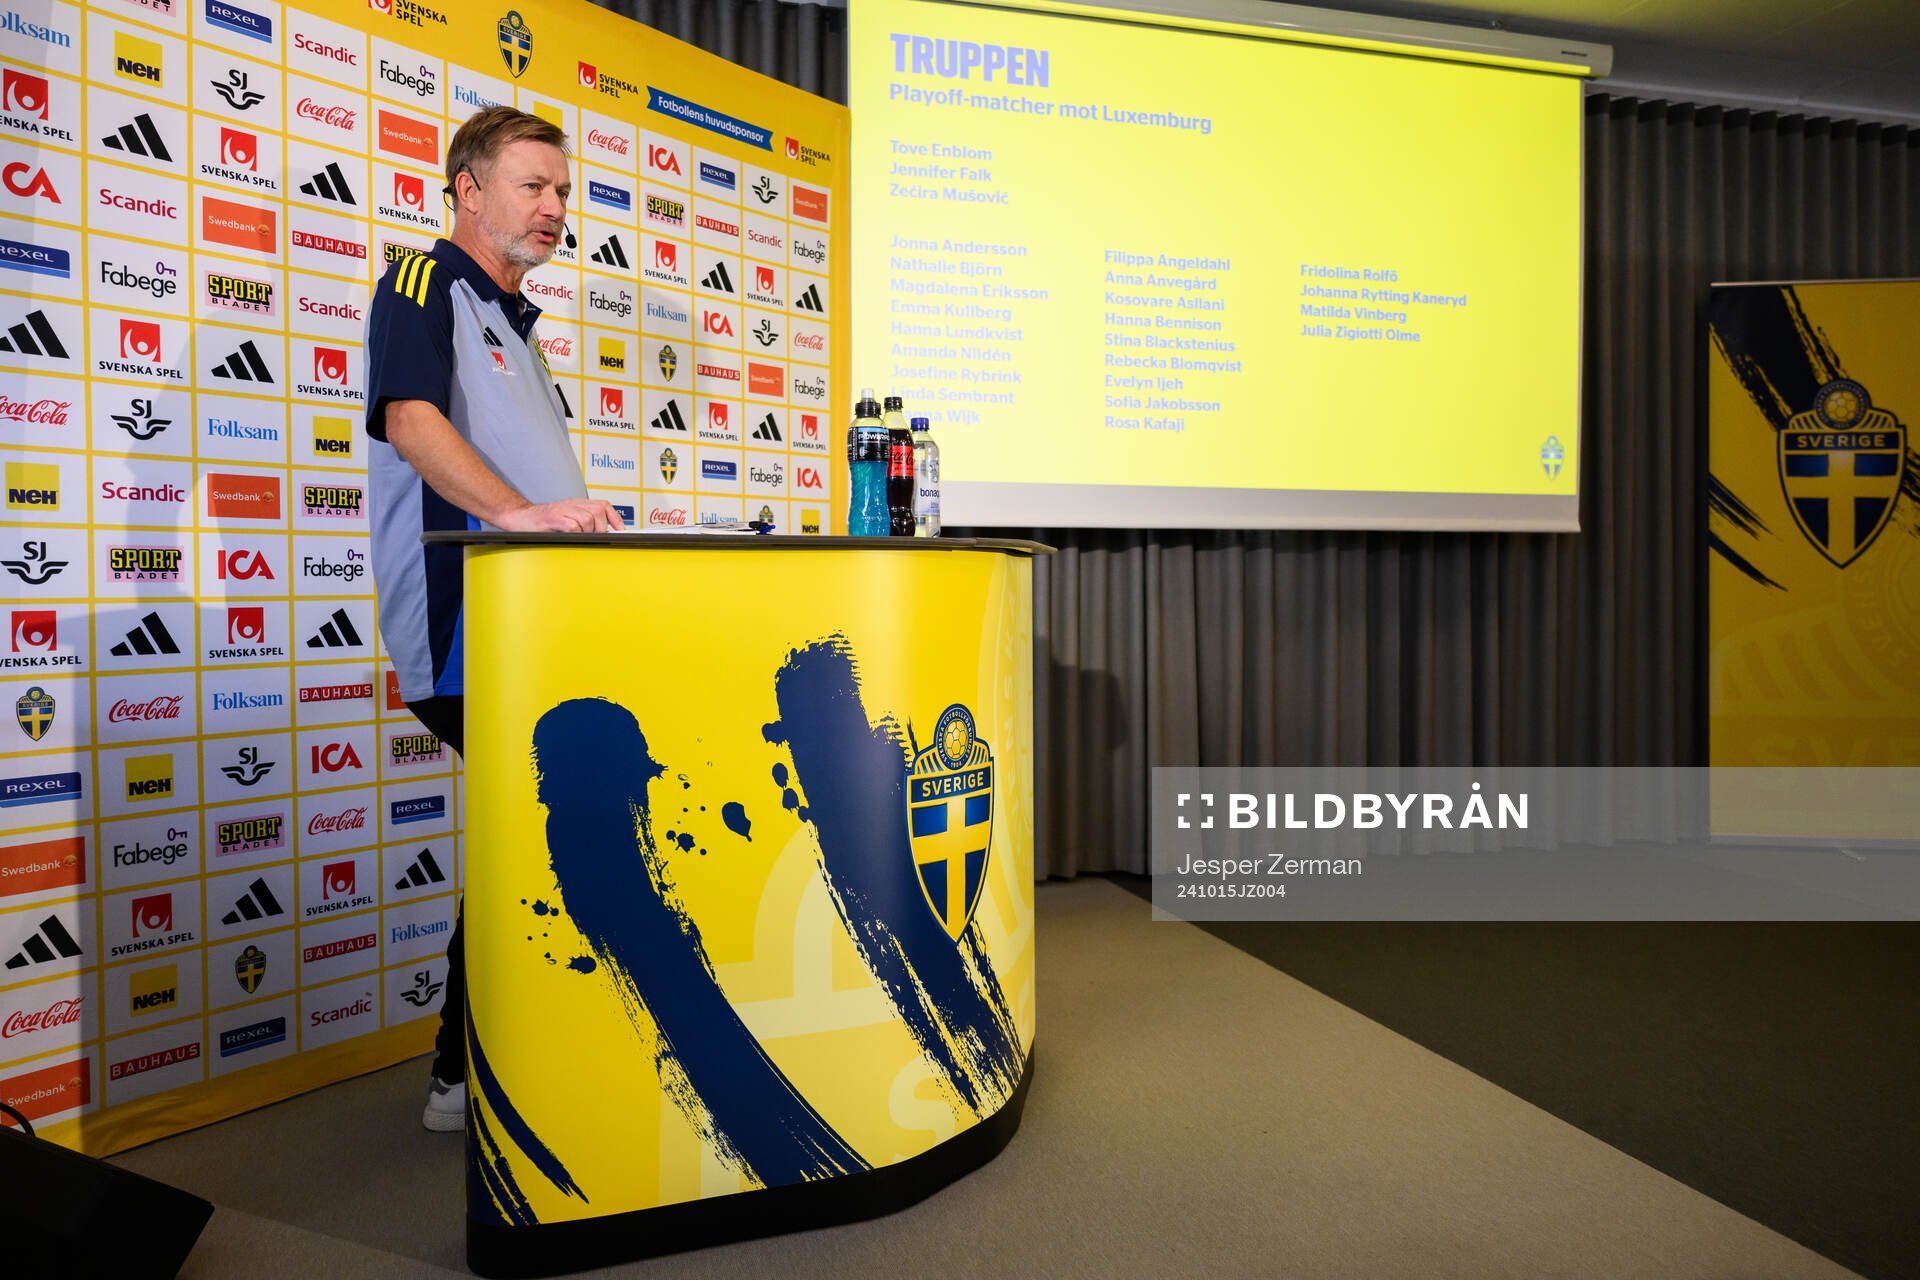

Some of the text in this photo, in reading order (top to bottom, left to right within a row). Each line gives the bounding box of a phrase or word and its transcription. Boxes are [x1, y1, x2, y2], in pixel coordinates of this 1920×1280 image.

[396, 9, 423, 27] SPEL
[0, 11, 71, 48] olksam
[294, 33, 357, 67] Scandic
[890, 33, 1049, 87] TRUPPEN
[229, 69, 248, 90] SJ
[380, 60, 435, 96] Fabege
[600, 74, 639, 95] SVENSKA
[600, 84, 621, 99] SPEL
[296, 97, 356, 132] Coca-Cola
[889, 82, 1212, 134] Playoff-matcher mot Luxemburg
[657, 96, 764, 144] Fotbollens huvudsponsor
[43, 126, 73, 142] SPEL
[383, 127, 422, 145] Swedbank
[588, 129, 630, 155] Coca-Cola
[649, 145, 681, 175] ICA
[890, 140, 993, 161] Tove Enblom
[201, 164, 277, 190] SVENSKA SPEL
[889, 161, 992, 182] Jennifer Falk
[2, 162, 62, 204] CA
[889, 182, 1009, 205] Zećira Mušović
[100, 188, 177, 220] Scandic
[208, 216, 256, 232] Swedbank
[379, 206, 440, 228] SVENSKA SPEL
[697, 216, 739, 237] BAUHAUS
[293, 230, 366, 259] BAUHAUS
[748, 230, 782, 248] Scandic
[890, 234, 1028, 257] Jonna Andersson
[794, 241, 826, 264] Fabege
[1105, 250, 1231, 272] Filippa Angeldahl
[645, 269, 688, 285] SVENSKA SPEL
[890, 256, 1003, 279] Nathalie Björn
[1300, 264, 1398, 282] Fridolina Rolfö
[102, 262, 176, 297] Fabege
[208, 275, 272, 305] SPORT
[526, 279, 573, 300] Scandic
[890, 278, 1049, 301] Magdalena Eriksson
[1105, 271, 1217, 291] Anna Anvegård
[212, 297, 270, 312] BLADET
[590, 291, 632, 318] Fabege
[1105, 292, 1173, 309] Kosovare
[1300, 284, 1467, 308] Johanna Rytting Kaneryd
[299, 297, 361, 321] Scandic
[647, 303, 687, 323] Folksam
[891, 300, 1012, 322] Emma Kullberg
[1300, 304, 1407, 324] Matilda Vinberg
[704, 311, 734, 336] ICA
[891, 321, 1023, 342] Hanna Lundkvist
[1105, 312, 1222, 332] Hanna Bennison
[1300, 323, 1421, 342] Julia Zigiotti Olme
[891, 343, 1012, 363] Amanda Nildén
[1105, 333, 1235, 352] Stina Blackstenius
[99, 361, 183, 380] SVENSKA SPEL
[698, 365, 740, 380] BAUHAUS
[890, 364, 1022, 385] Josefine Rybrink
[1105, 354, 1243, 374] Rebecka Blomqvist
[297, 385, 364, 399] SVENSKA SPEL
[795, 380, 825, 399] Fabege
[1105, 375, 1184, 393] Evelyn Ijeh
[939, 389, 1015, 406] Sembrant
[1105, 395, 1221, 413] Sofia Jakobsson
[131, 399, 152, 419] SJ
[208, 418, 278, 441] Folksam
[589, 419, 617, 429] SVENSKA
[1105, 416, 1186, 433] Rosa Kafaji
[1797, 434, 1885, 448] SVERIGE
[591, 454, 634, 470] Folksam
[750, 467, 783, 488] Fabege
[797, 468, 822, 489] ICA
[102, 482, 185, 503] Scandic
[213, 491, 260, 502] Swedbank
[305, 487, 361, 509] SPORT
[307, 508, 360, 516] BLADET
[23, 541, 48, 561] SJ
[111, 548, 181, 571] SPORT
[218, 550, 274, 580] ICA
[304, 557, 363, 582] Fabege
[114, 572, 178, 580] BLADET
[52, 656, 82, 665] SPEL
[209, 646, 284, 659] SVENSKA SPEL
[213, 692, 283, 711] Folksam
[300, 683, 373, 701] BAUHAUS
[109, 696, 184, 722] Coca-Cola
[238, 747, 258, 764] SJ
[312, 742, 363, 774] ICA
[395, 754, 443, 764] BLADET
[922, 771, 984, 798] SVERIGE
[218, 818, 280, 844] SPORT
[308, 806, 368, 835] Coca-Cola
[114, 841, 187, 867] Fabege
[222, 839, 280, 854] BLADET
[1, 859, 60, 878] Swedbank
[306, 896, 374, 916] SVENSKA SPEL
[391, 920, 449, 944] Folksam
[111, 931, 195, 957] SVENSKA SPEL
[303, 934, 376, 963] BAUHAUS
[414, 971, 430, 988] SJ
[1, 998, 86, 1039] Coca-Cola
[311, 1000, 372, 1027] Scandic
[109, 1043, 200, 1081] BAUHAUS
[8, 1086, 66, 1110] Swedbank
